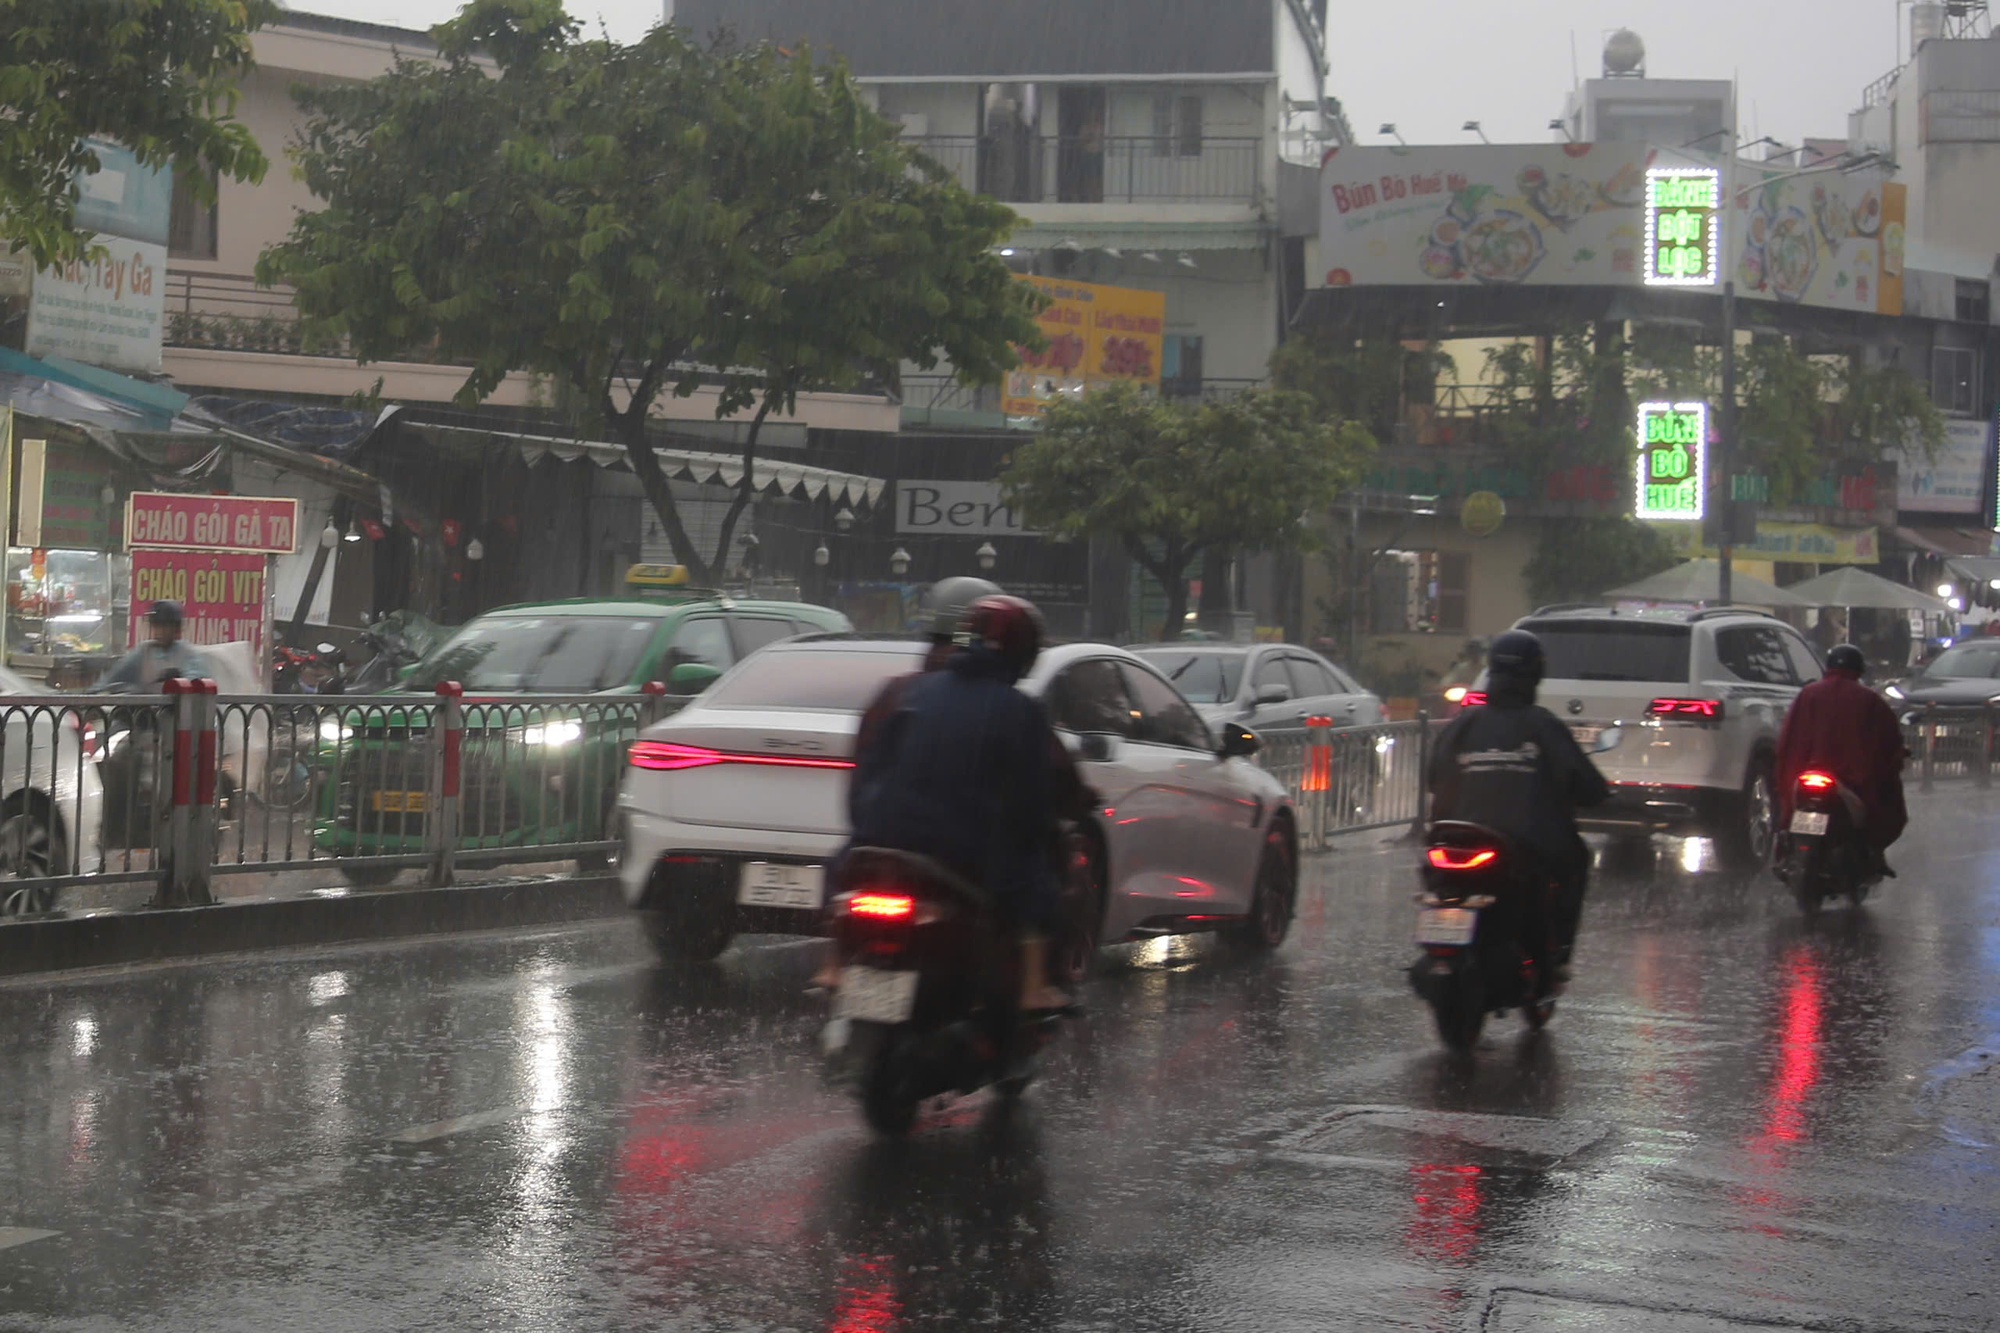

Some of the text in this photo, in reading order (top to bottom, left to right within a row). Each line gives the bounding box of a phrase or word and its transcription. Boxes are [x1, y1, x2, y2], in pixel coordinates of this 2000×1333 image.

[1332, 182, 1377, 214] Bún
[1380, 175, 1406, 202] Bò
[131, 252, 152, 296] Ga
[1657, 246, 1702, 279] LỌC
[1645, 410, 1697, 443] BÚN
[1651, 443, 1688, 478] BÒ
[1645, 476, 1696, 511] HUẾ
[133, 504, 187, 542] CHÁO
[194, 503, 228, 544] GỎI
[235, 508, 262, 546] GÀ
[269, 515, 291, 547] TA
[136, 558, 261, 612] CHÁO GỎI VỊT
